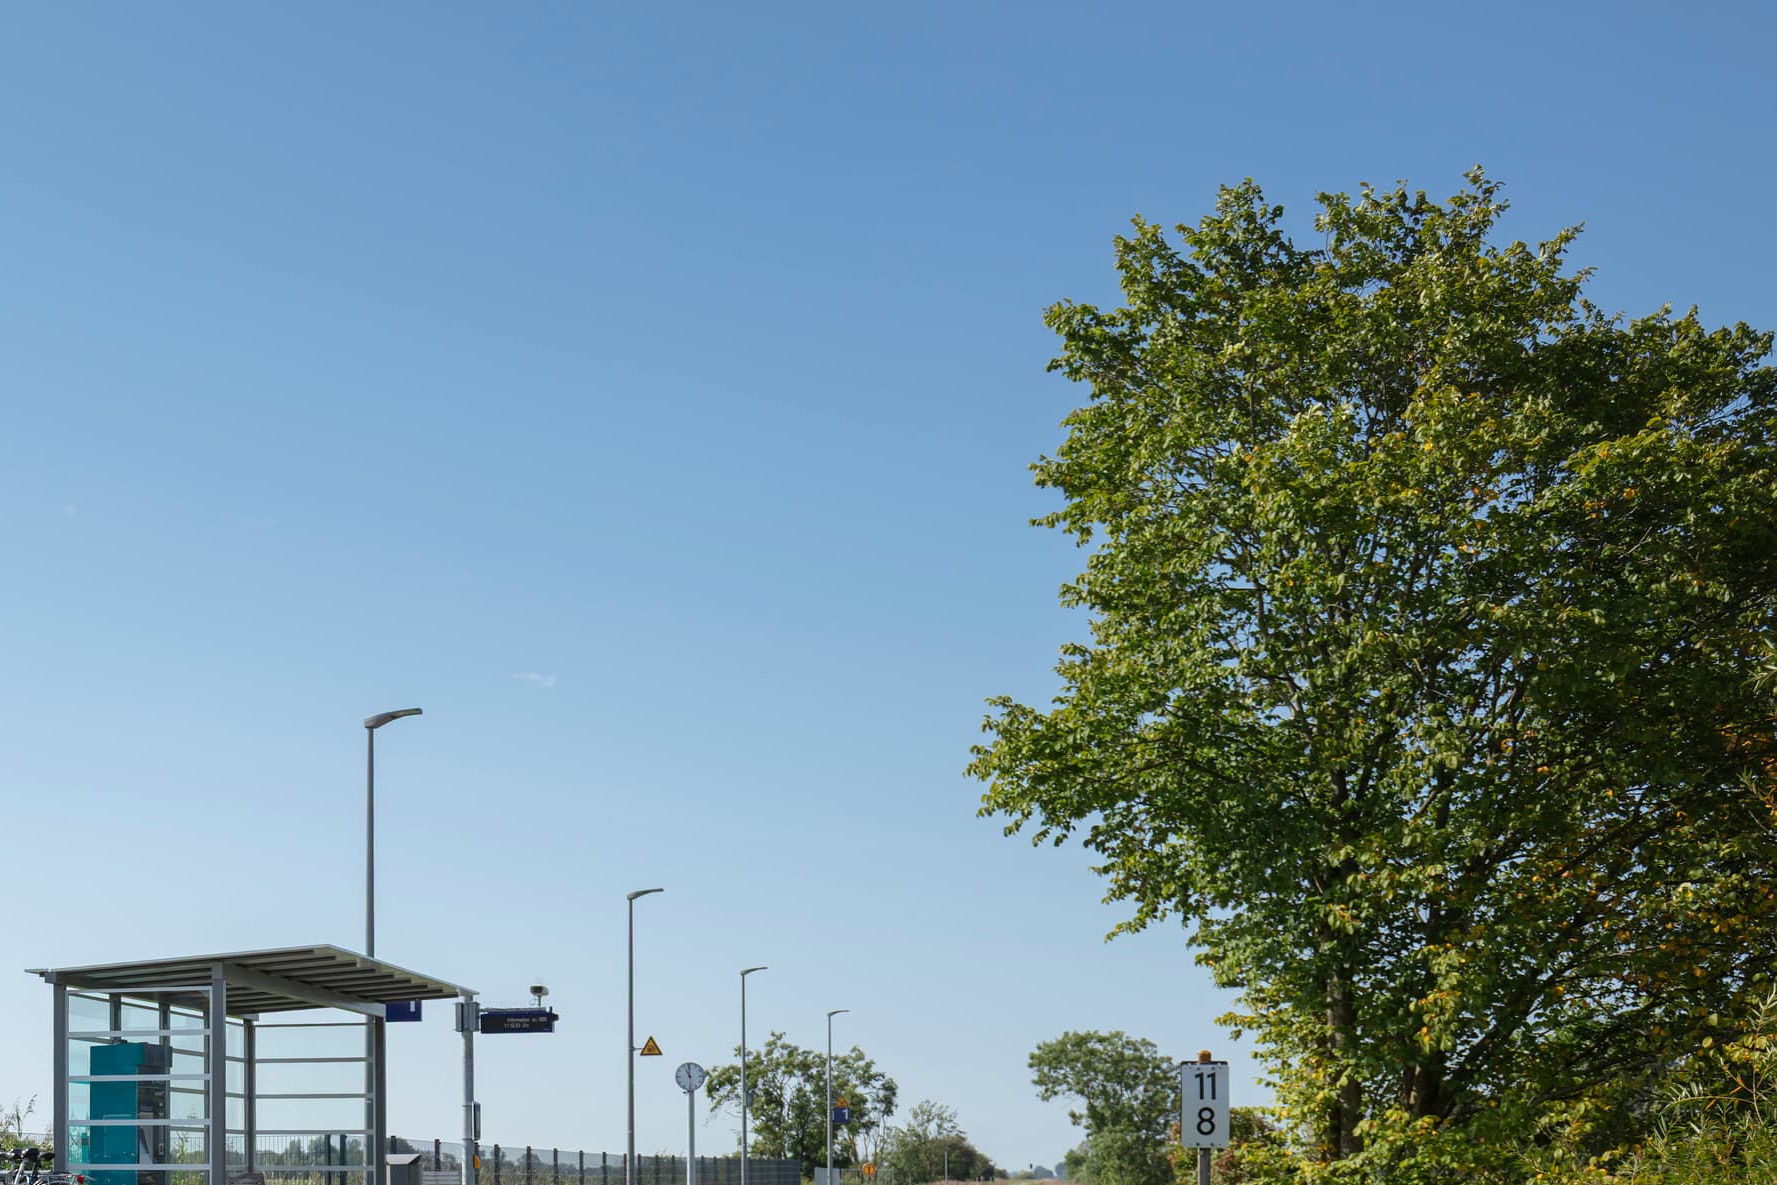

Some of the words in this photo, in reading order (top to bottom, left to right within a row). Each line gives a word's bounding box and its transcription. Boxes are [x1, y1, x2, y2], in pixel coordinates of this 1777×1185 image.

[1195, 1071, 1216, 1100] 11
[842, 1108, 849, 1120] 1
[1196, 1106, 1215, 1135] 8
